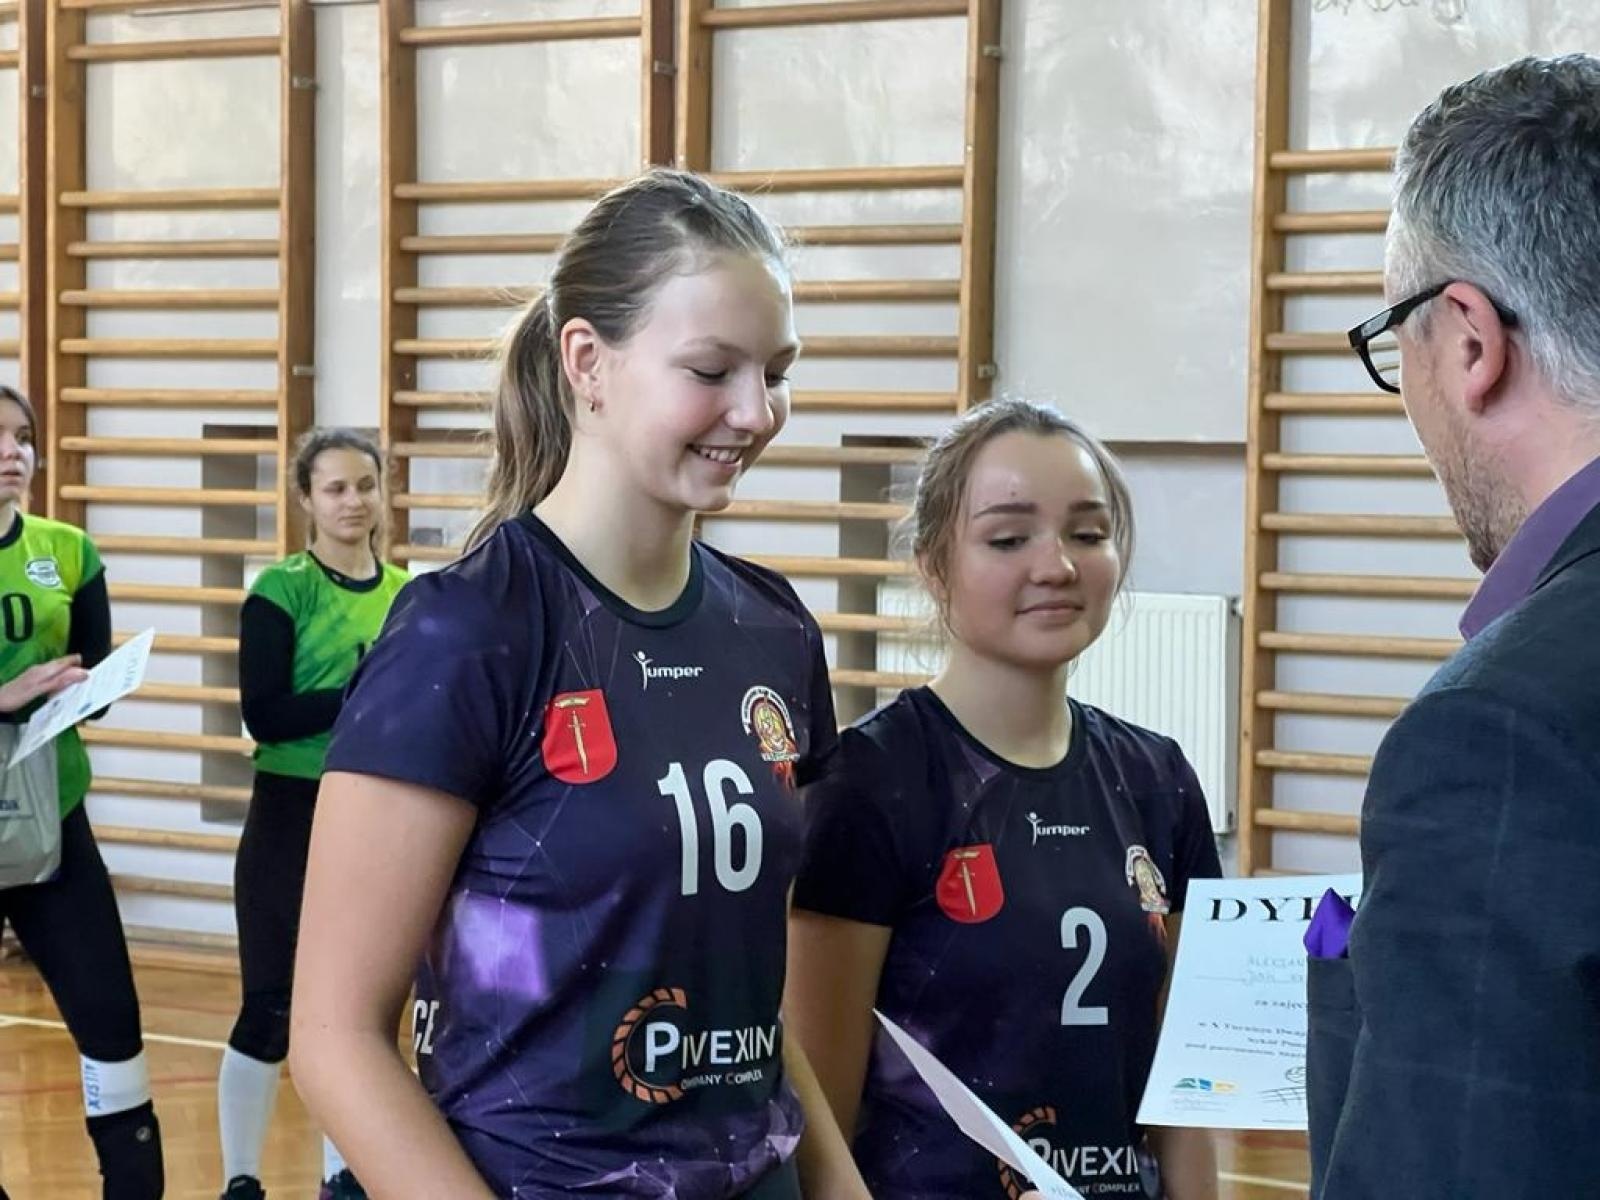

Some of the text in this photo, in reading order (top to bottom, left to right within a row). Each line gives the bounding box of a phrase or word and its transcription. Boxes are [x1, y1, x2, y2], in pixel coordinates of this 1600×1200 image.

[657, 759, 763, 896] 16
[1060, 906, 1109, 1026] 2
[644, 1021, 777, 1073] PIVEXIN
